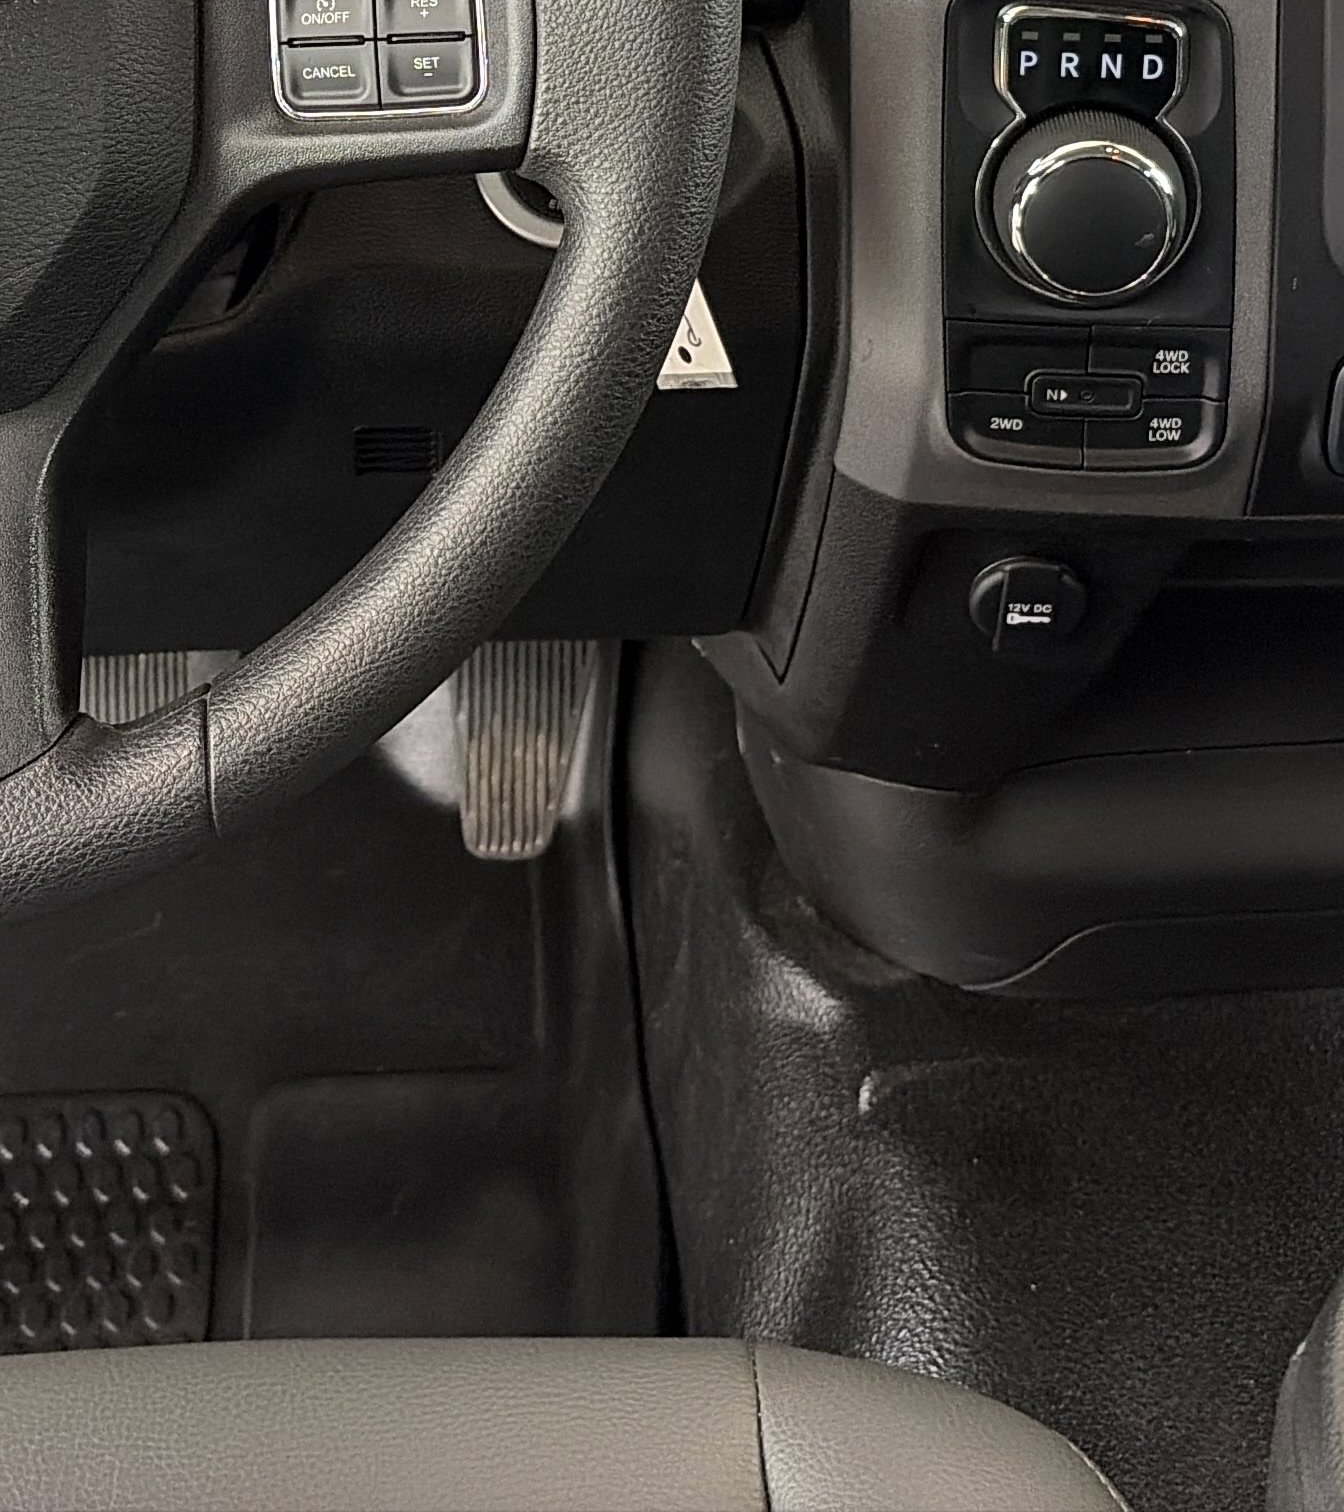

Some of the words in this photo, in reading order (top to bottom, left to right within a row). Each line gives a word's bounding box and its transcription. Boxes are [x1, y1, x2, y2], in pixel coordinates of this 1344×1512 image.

[301, 11, 350, 25] ON/OFF
[413, 57, 440, 69] SET
[1019, 50, 1039, 76] P
[1060, 52, 1079, 78] R
[1100, 53, 1122, 79] N
[1142, 54, 1164, 80] D
[303, 65, 356, 79] CANCEL
[1155, 350, 1189, 362] 4WD
[1152, 362, 1190, 374] LOCK
[1046, 389, 1058, 401] N
[990, 418, 1023, 431] 2WD
[1150, 417, 1183, 429] 4WD
[1148, 429, 1182, 441] LOW
[1008, 603, 1030, 613] 12V
[1033, 603, 1052, 613] DC
